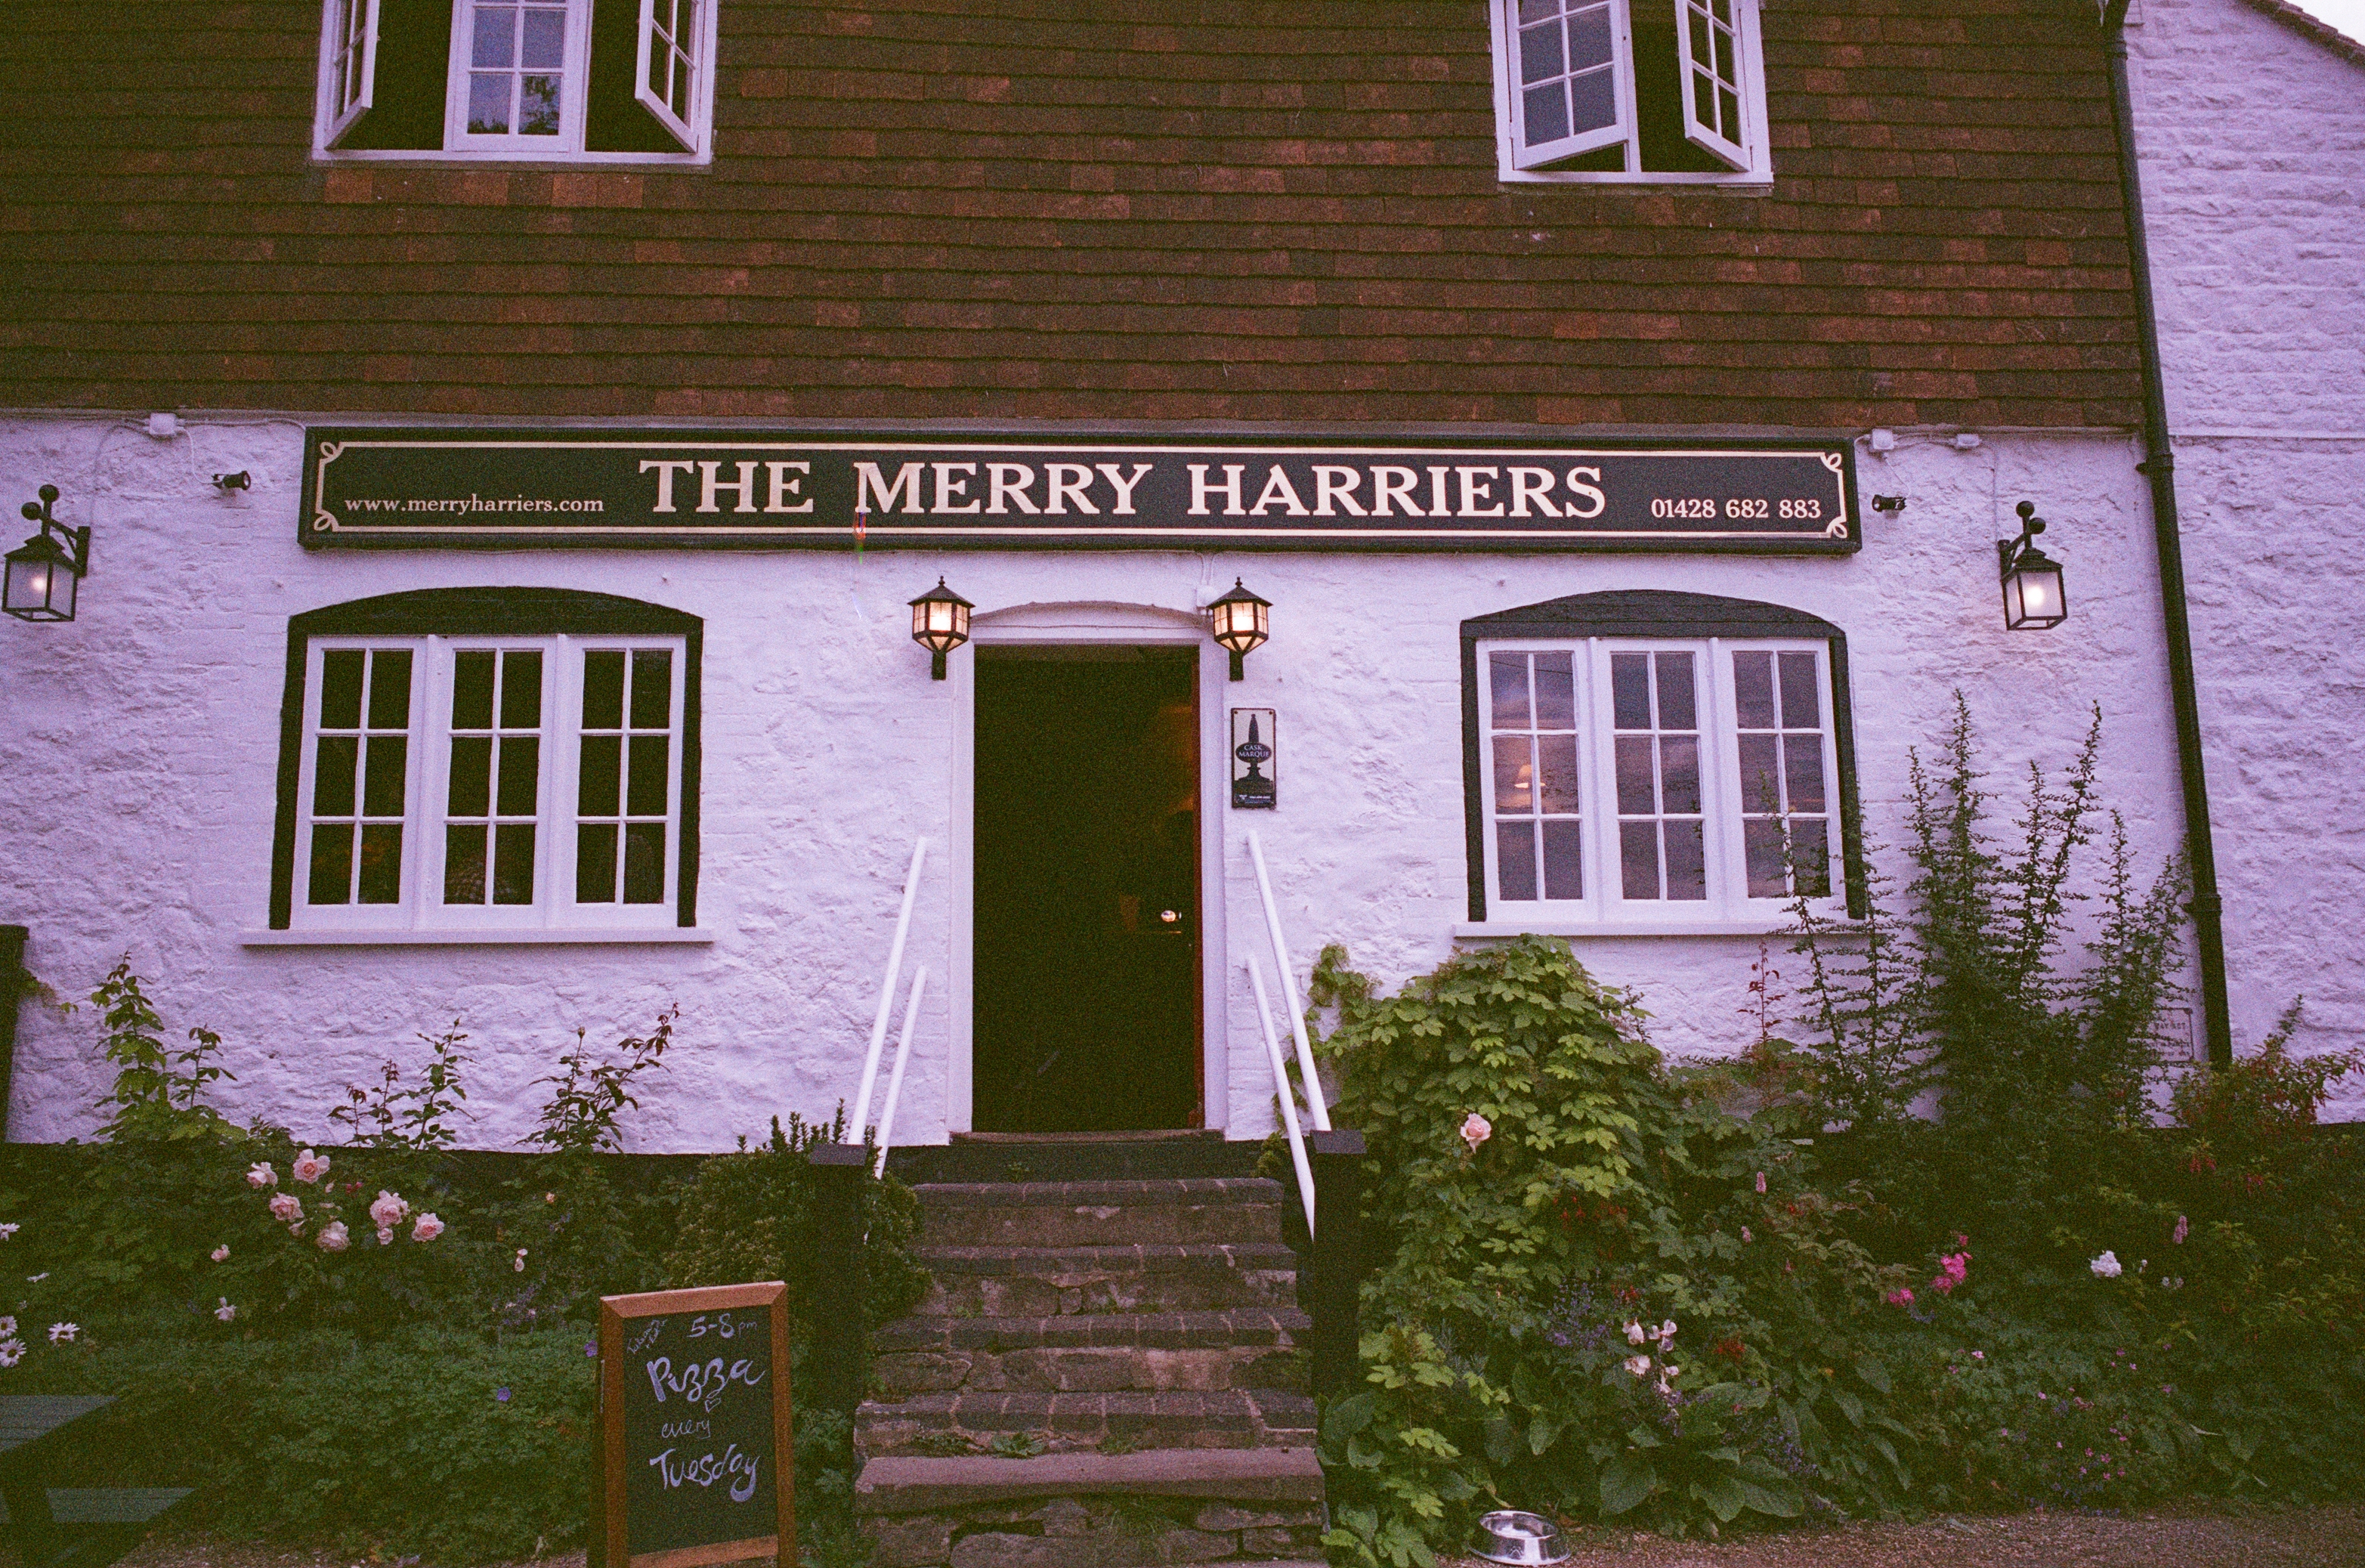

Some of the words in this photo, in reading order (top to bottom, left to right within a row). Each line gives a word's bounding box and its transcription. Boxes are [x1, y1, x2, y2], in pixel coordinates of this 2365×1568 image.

[640, 460, 813, 512] THE
[854, 462, 1152, 514] MERRY
[1186, 464, 1606, 518] HARRIERS
[345, 493, 604, 515] www.merryharriers.com
[1651, 499, 1716, 518] 01428
[1725, 499, 1769, 518] 682
[1779, 499, 1821, 518] 883
[687, 1313, 734, 1338] 5-8
[738, 1321, 757, 1338] pm
[646, 1356, 765, 1402] Pizza
[661, 1419, 711, 1439] every
[649, 1443, 759, 1502] Tuesday
